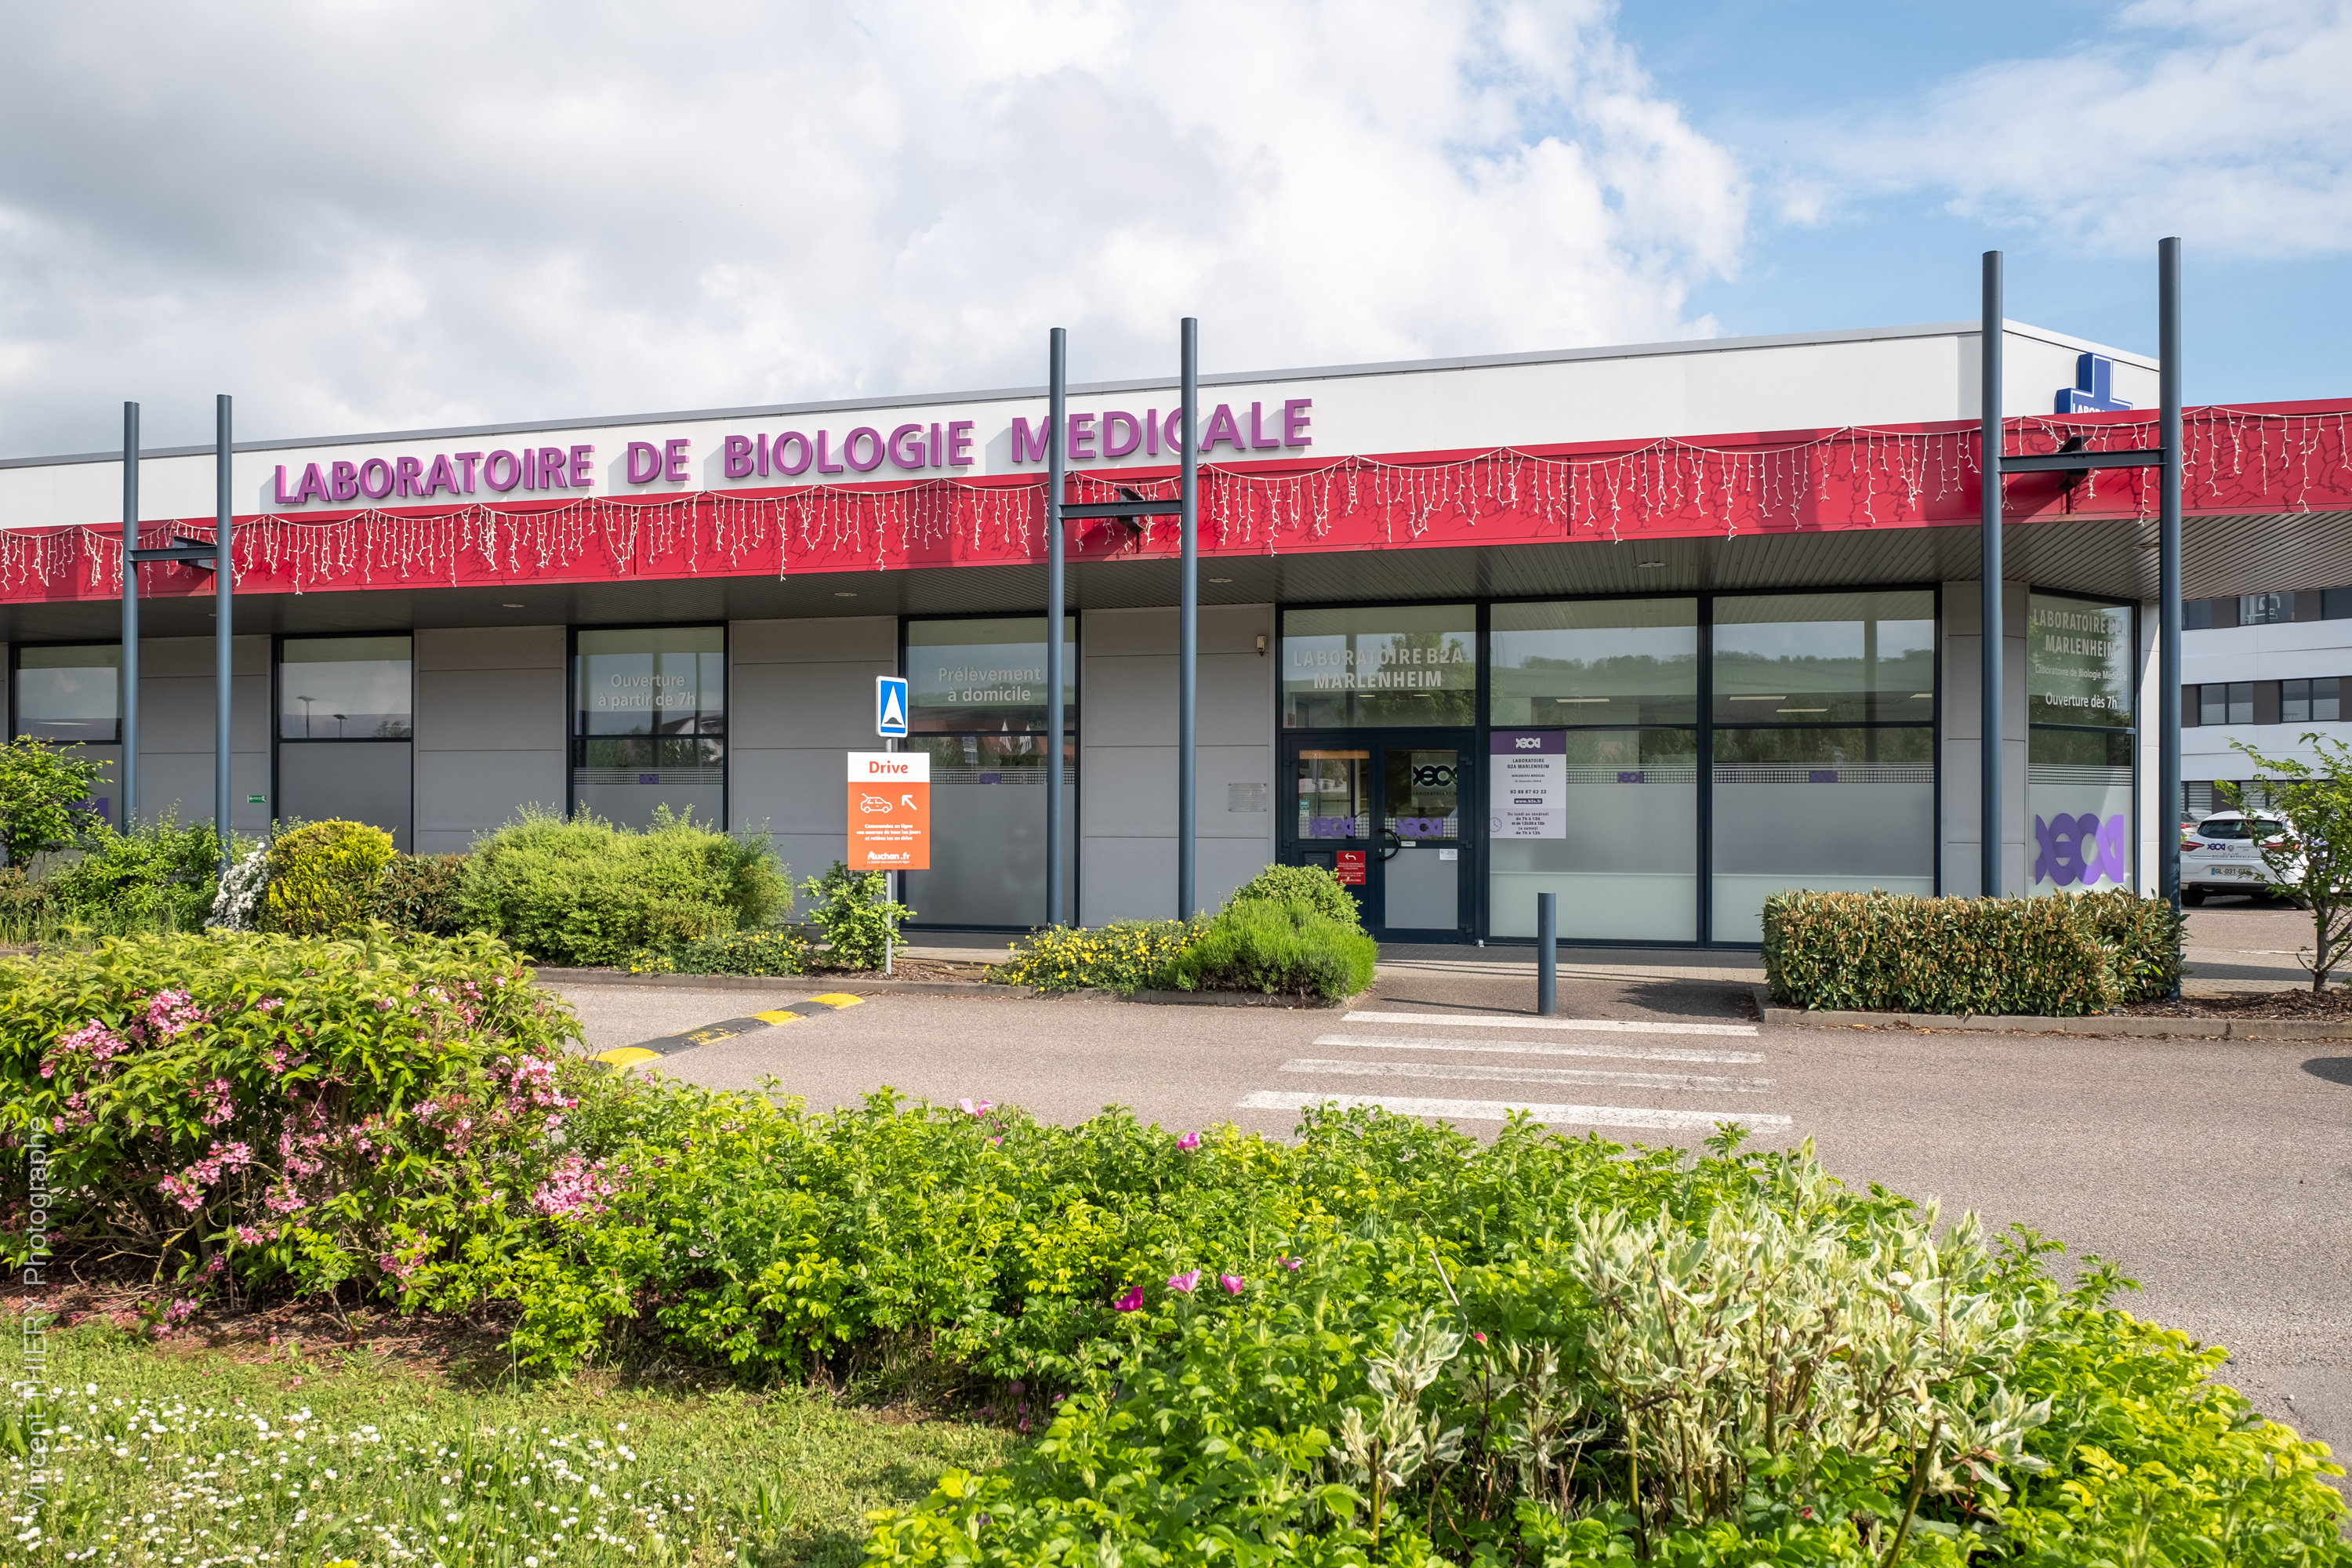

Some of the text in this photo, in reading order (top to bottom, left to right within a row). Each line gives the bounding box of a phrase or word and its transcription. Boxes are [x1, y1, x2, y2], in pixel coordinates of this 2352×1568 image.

[274, 398, 1312, 504] LABORATOIRE DE BIOLOGIE MEDICALE
[2033, 608, 2106, 634] LABORATOIRE
[1294, 648, 1464, 666] LABORATOIRE B2A
[611, 673, 686, 688] Ouverture
[938, 666, 1042, 682] Prélèvement
[1314, 670, 1442, 688] MARLENHEIM
[2035, 664, 2128, 681] Laboratoire de Biologie Médicale
[598, 691, 697, 710] à partir de 7h
[948, 686, 1032, 702] à domicile
[2045, 691, 2118, 710] Ouverture dès 7h
[869, 760, 909, 774] Drive
